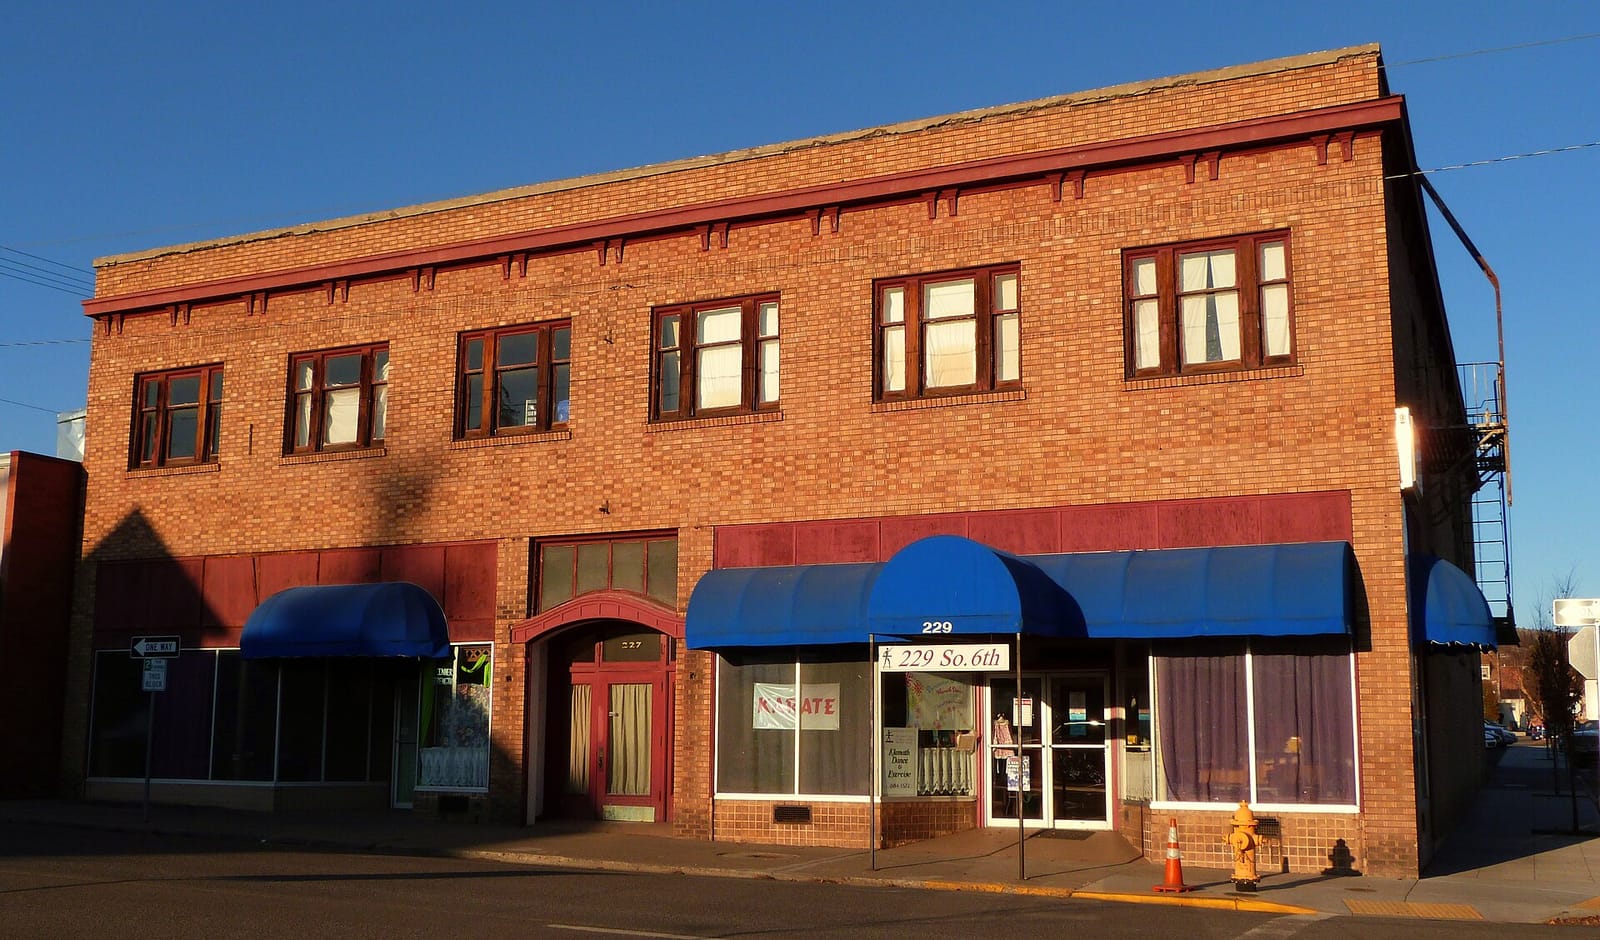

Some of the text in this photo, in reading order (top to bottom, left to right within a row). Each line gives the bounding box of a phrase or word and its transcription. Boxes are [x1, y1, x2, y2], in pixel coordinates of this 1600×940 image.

[922, 621, 953, 633] 229
[145, 643, 173, 652] ONE WAY
[621, 641, 642, 649] 227
[898, 648, 1001, 667] 229 So. 6th
[144, 659, 151, 670] 2
